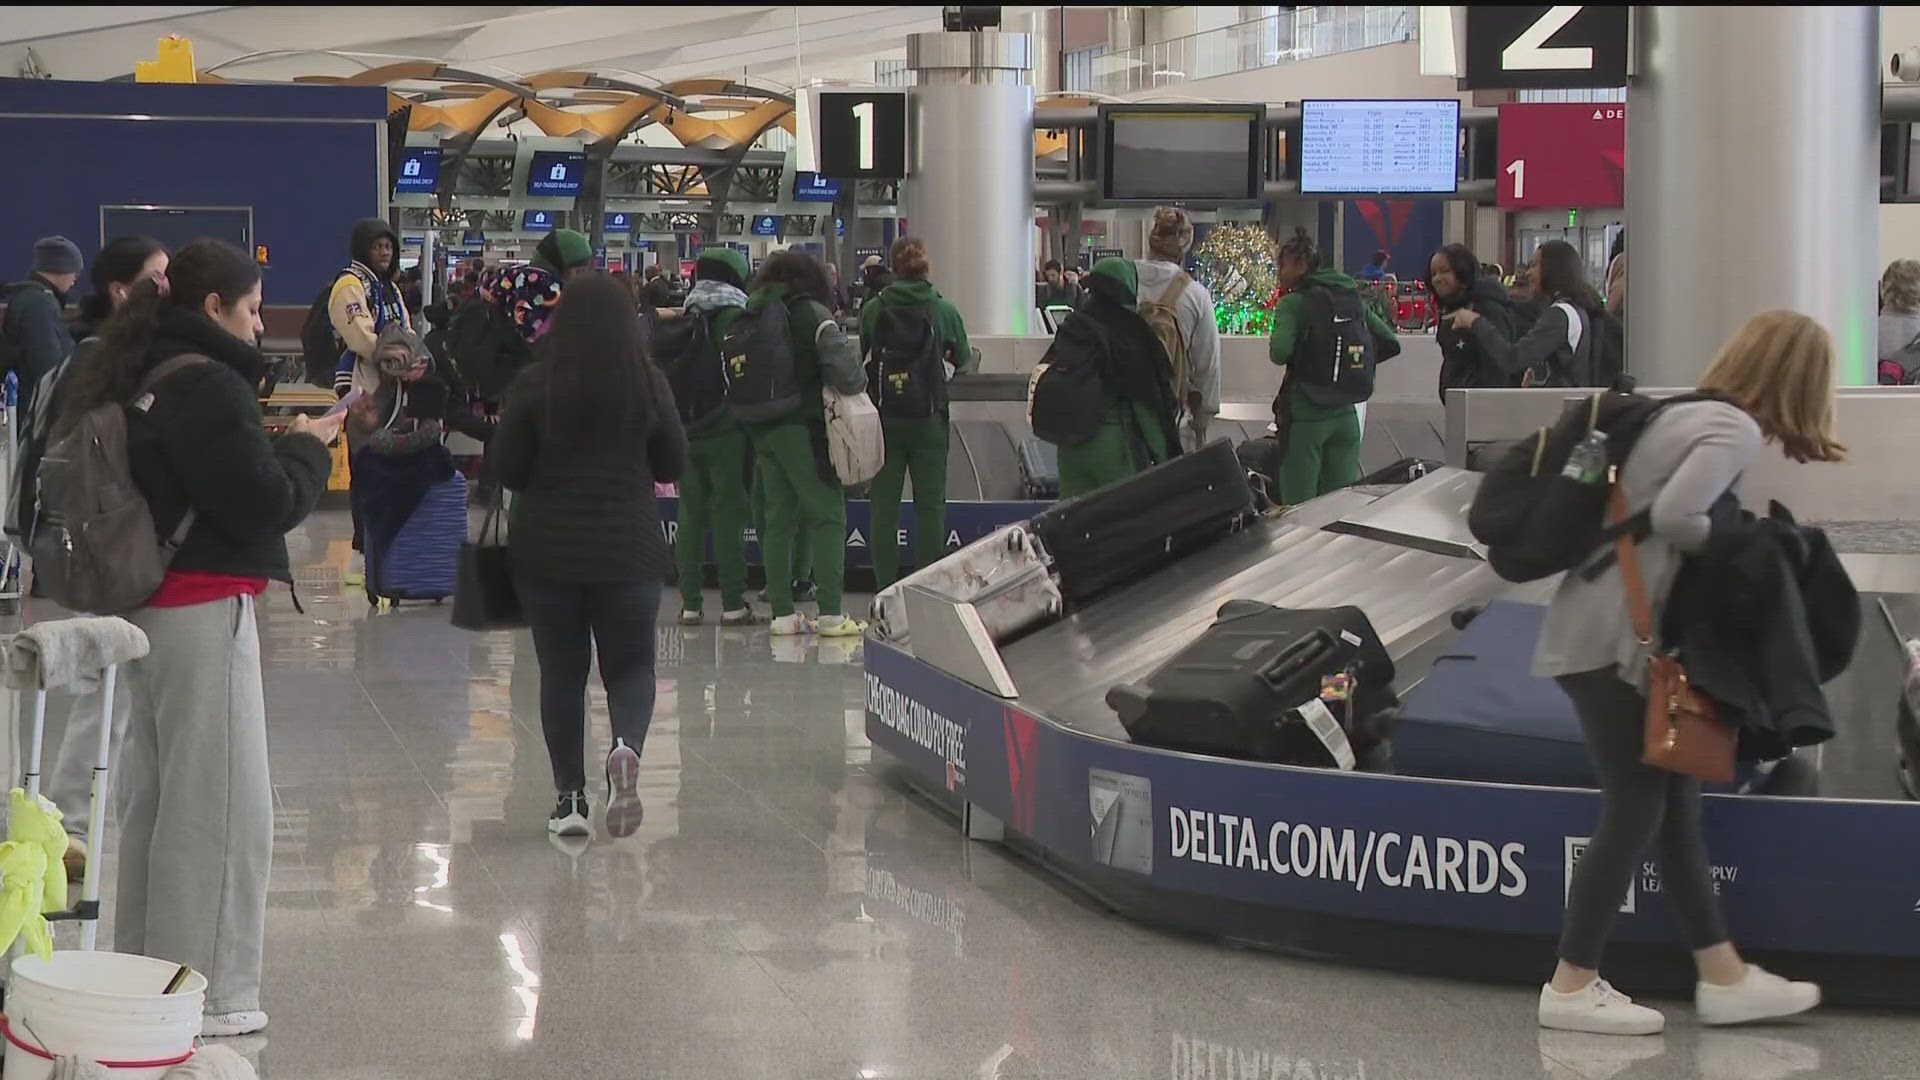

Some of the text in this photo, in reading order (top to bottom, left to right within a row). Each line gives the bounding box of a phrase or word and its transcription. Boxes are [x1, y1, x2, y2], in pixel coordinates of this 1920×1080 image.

[1502, 6, 1593, 70] 2
[852, 102, 873, 169] 1
[1506, 160, 1525, 198] 1
[868, 673, 895, 728] CHECKED
[896, 691, 910, 737] BAG
[910, 699, 933, 750] COULD
[933, 711, 945, 757] FLY
[1169, 806, 1528, 897] DELTA.COM/CARDS
